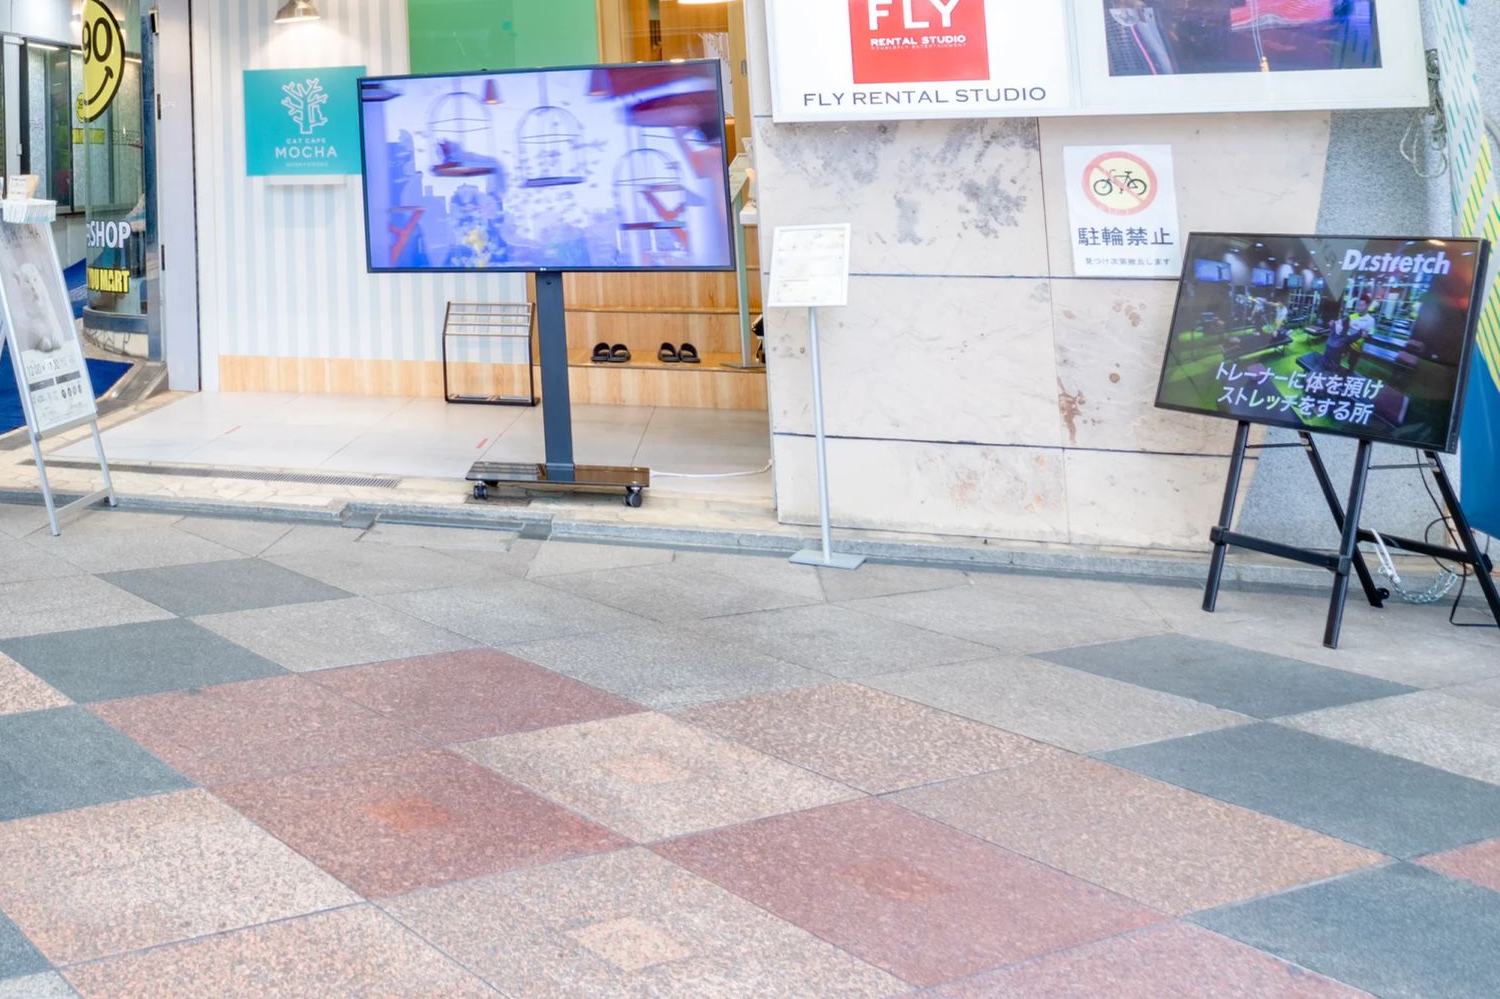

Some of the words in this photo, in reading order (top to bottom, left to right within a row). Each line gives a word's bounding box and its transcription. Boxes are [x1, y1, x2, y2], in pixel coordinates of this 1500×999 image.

[870, 36, 918, 47] RENTAL
[921, 34, 967, 45] STUDIO
[804, 92, 845, 108] FLY
[852, 89, 949, 106] RENTAL
[955, 86, 1047, 104] STUDIO
[275, 146, 338, 158] MOCHA
[1077, 226, 1174, 247] 駐輪禁止
[1341, 248, 1451, 275] Dr.stretch
[1215, 361, 1385, 400] トレーナーに体を預け
[1217, 386, 1375, 425] ストレッチをする所
